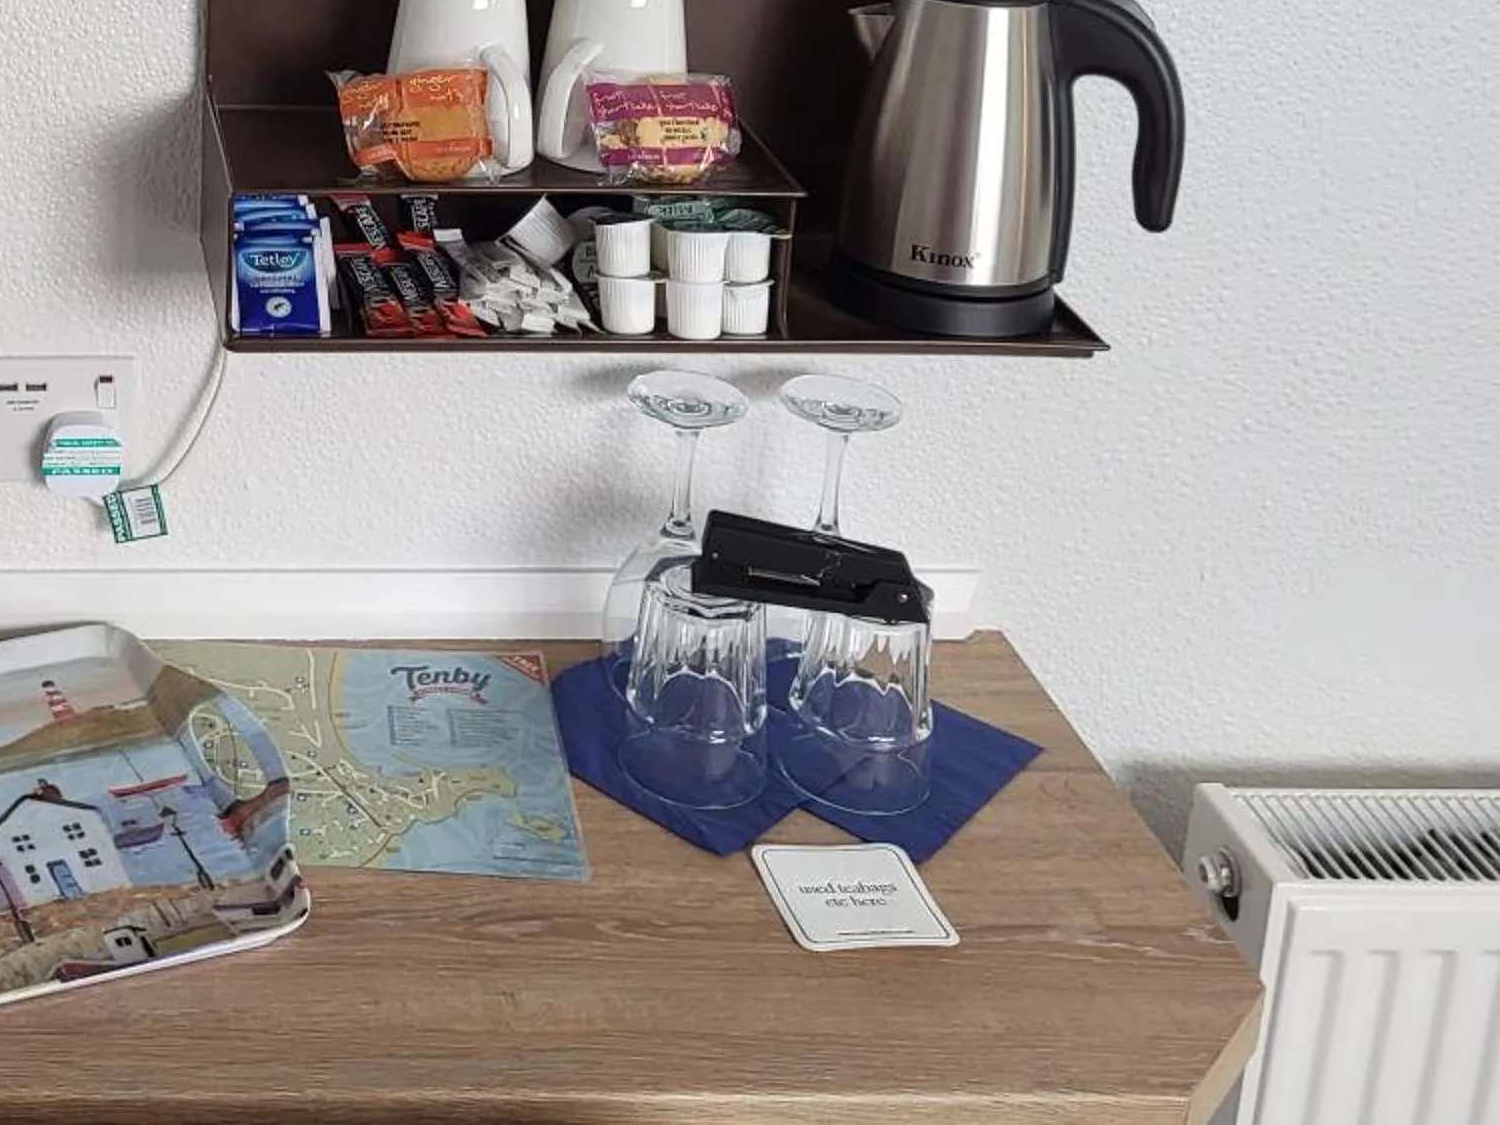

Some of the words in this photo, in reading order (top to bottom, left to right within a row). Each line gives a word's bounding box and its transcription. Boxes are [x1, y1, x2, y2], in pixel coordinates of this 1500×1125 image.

[249, 251, 301, 269] Tetley
[909, 243, 974, 268] Kinox
[390, 664, 492, 692] Tenby
[849, 895, 887, 908] here
